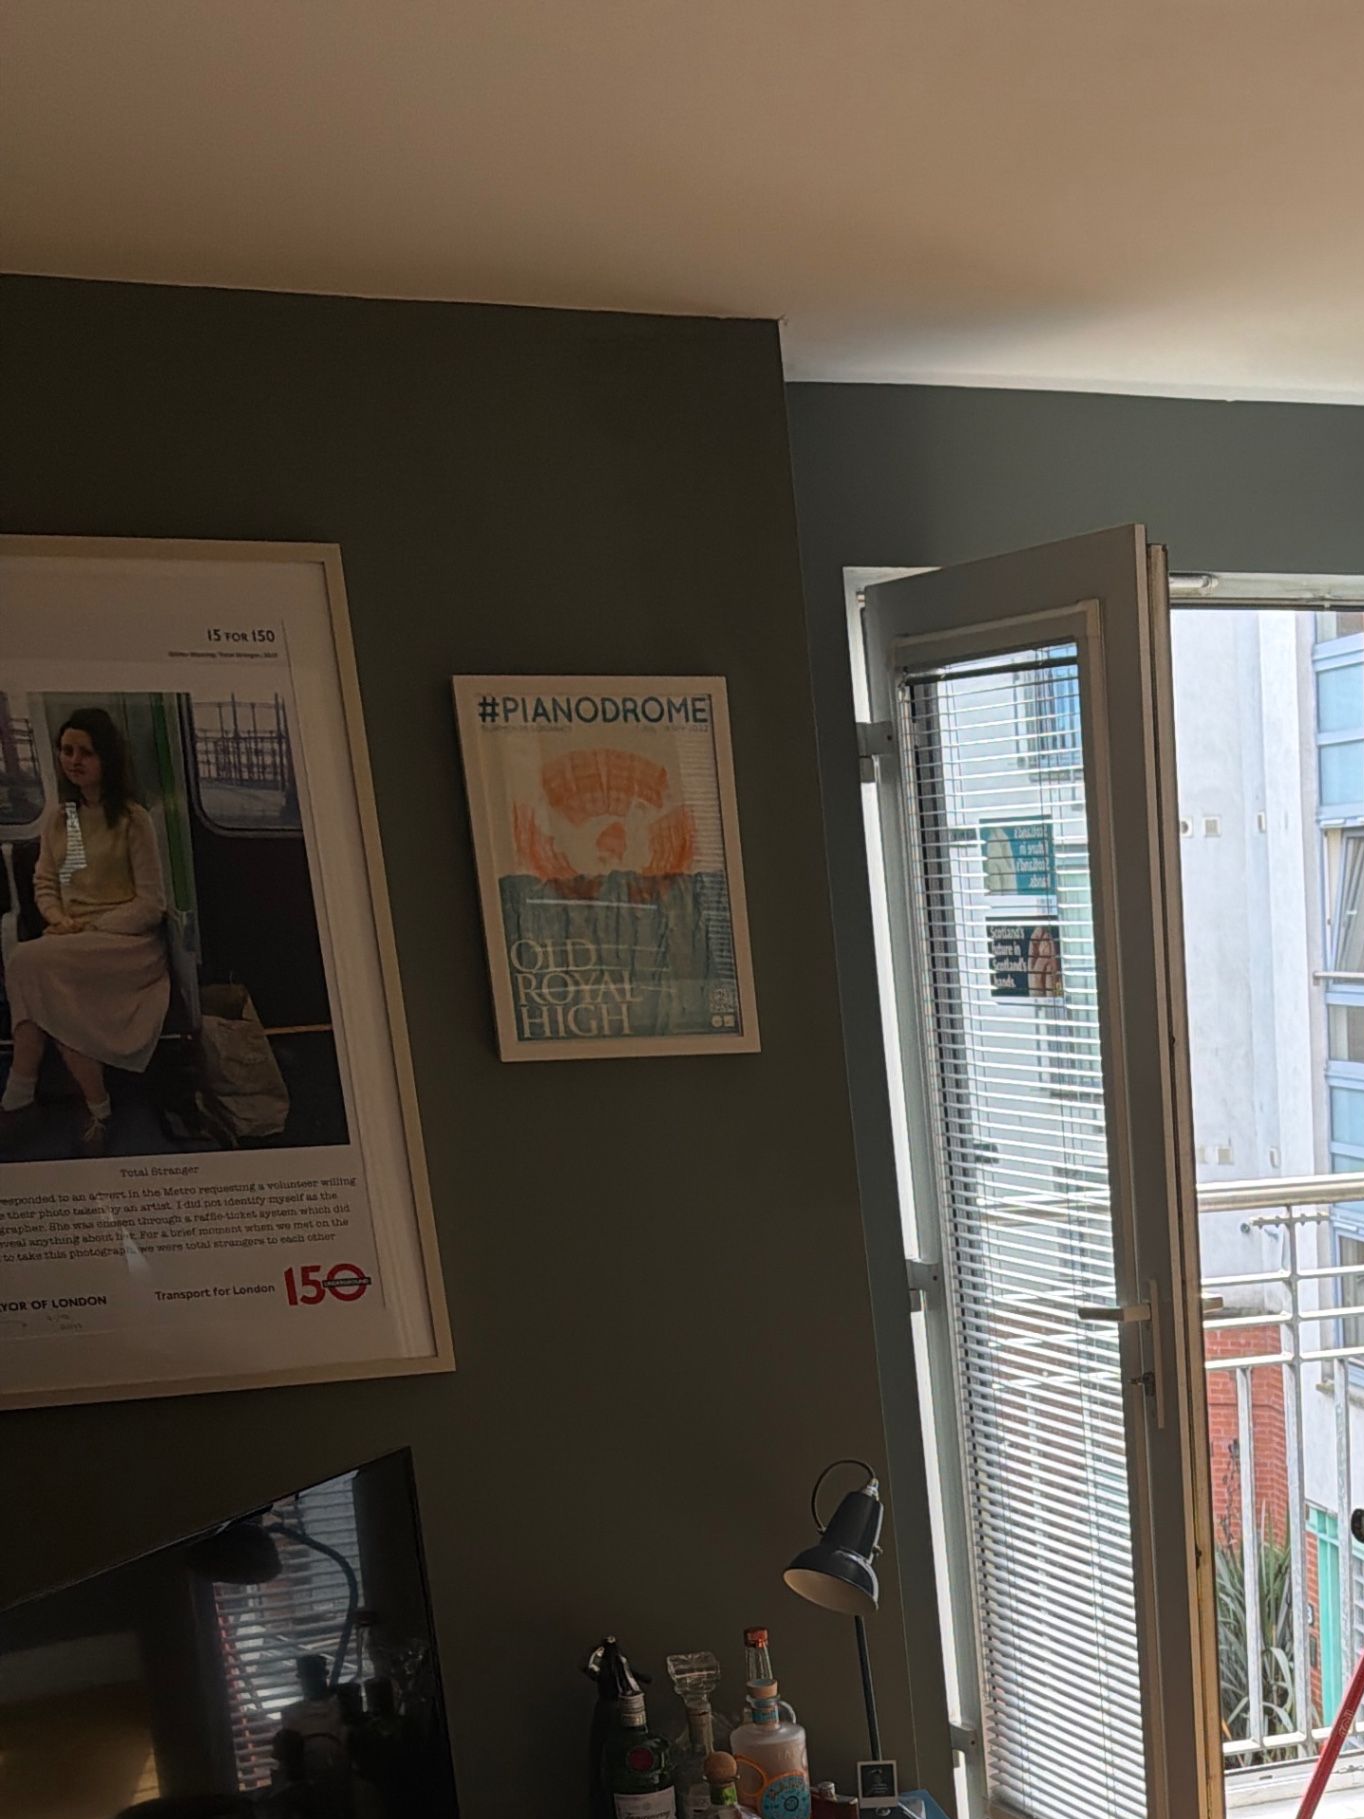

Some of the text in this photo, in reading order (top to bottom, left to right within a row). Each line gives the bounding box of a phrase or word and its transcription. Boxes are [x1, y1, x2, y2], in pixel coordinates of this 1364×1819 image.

[207, 628, 275, 642] 15 FOR 150
[478, 696, 709, 723] #PIANODROME
[990, 925, 1025, 939] Scotland's
[510, 938, 597, 973] OLD
[515, 970, 643, 1007] ROYAL
[520, 1002, 634, 1039] HIGH
[120, 1166, 200, 1178] Total Stranger
[58, 1194, 69, 1202] to
[72, 1194, 86, 1202] an
[128, 1190, 140, 1198] in
[141, 1188, 161, 1198] the
[163, 1187, 196, 1197] Metro
[198, 1182, 256, 1195] requesting
[257, 1182, 266, 1191] a
[267, 1180, 320, 1190] volunteer
[320, 1176, 358, 1188] willing
[6, 1210, 36, 1220] their
[38, 1208, 70, 1220] photo
[73, 1206, 105, 1216] taken
[124, 1205, 138, 1213] an
[182, 1199, 201, 1209] did
[204, 1198, 222, 1208] not
[225, 1194, 266, 1208] identify
[268, 1192, 305, 1206] myself
[306, 1192, 318, 1202] as
[320, 1190, 338, 1200] the
[49, 1221, 70, 1231] She
[72, 1220, 94, 1230] was
[138, 1215, 182, 1228] through
[259, 1206, 298, 1220] system
[300, 1204, 332, 1216] which
[332, 1203, 351, 1214] did
[28, 1235, 80, 1248] anything
[82, 1232, 114, 1243] about
[140, 1230, 159, 1240] For
[170, 1226, 197, 1238] brief
[198, 1224, 243, 1235] moment
[244, 1222, 274, 1233] when
[276, 1222, 292, 1231] we
[293, 1220, 314, 1230] met
[316, 1220, 330, 1229] on
[331, 1217, 350, 1227] the
[3, 1254, 15, 1262] to
[17, 1251, 43, 1262] take
[44, 1250, 68, 1260] this
[69, 1246, 137, 1260] photograp
[156, 1243, 184, 1252] were
[186, 1240, 211, 1250] total
[213, 1236, 265, 1249] strangers
[266, 1236, 278, 1245] to
[280, 1233, 305, 1244] each
[306, 1232, 337, 1242] other
[154, 1282, 276, 1302] Transport for London
[283, 1263, 371, 1306] 150
[30, 1300, 48, 1311] OF
[52, 1296, 108, 1310] LONDON
